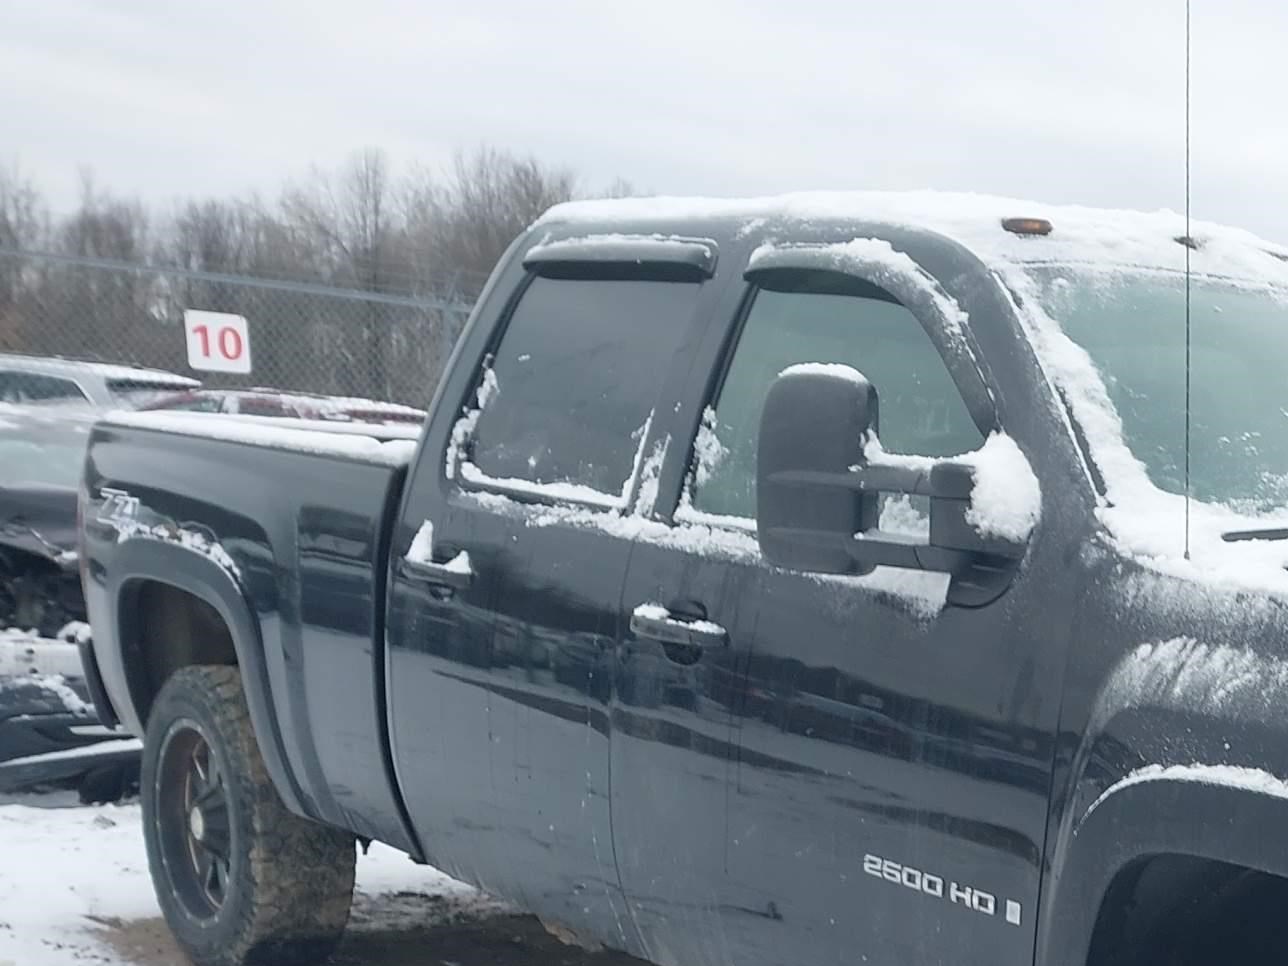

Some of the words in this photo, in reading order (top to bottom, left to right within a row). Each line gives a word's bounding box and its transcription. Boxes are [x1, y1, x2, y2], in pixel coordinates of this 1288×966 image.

[192, 325, 242, 360] 10
[863, 853, 943, 898] 2500
[949, 881, 996, 916] HD
